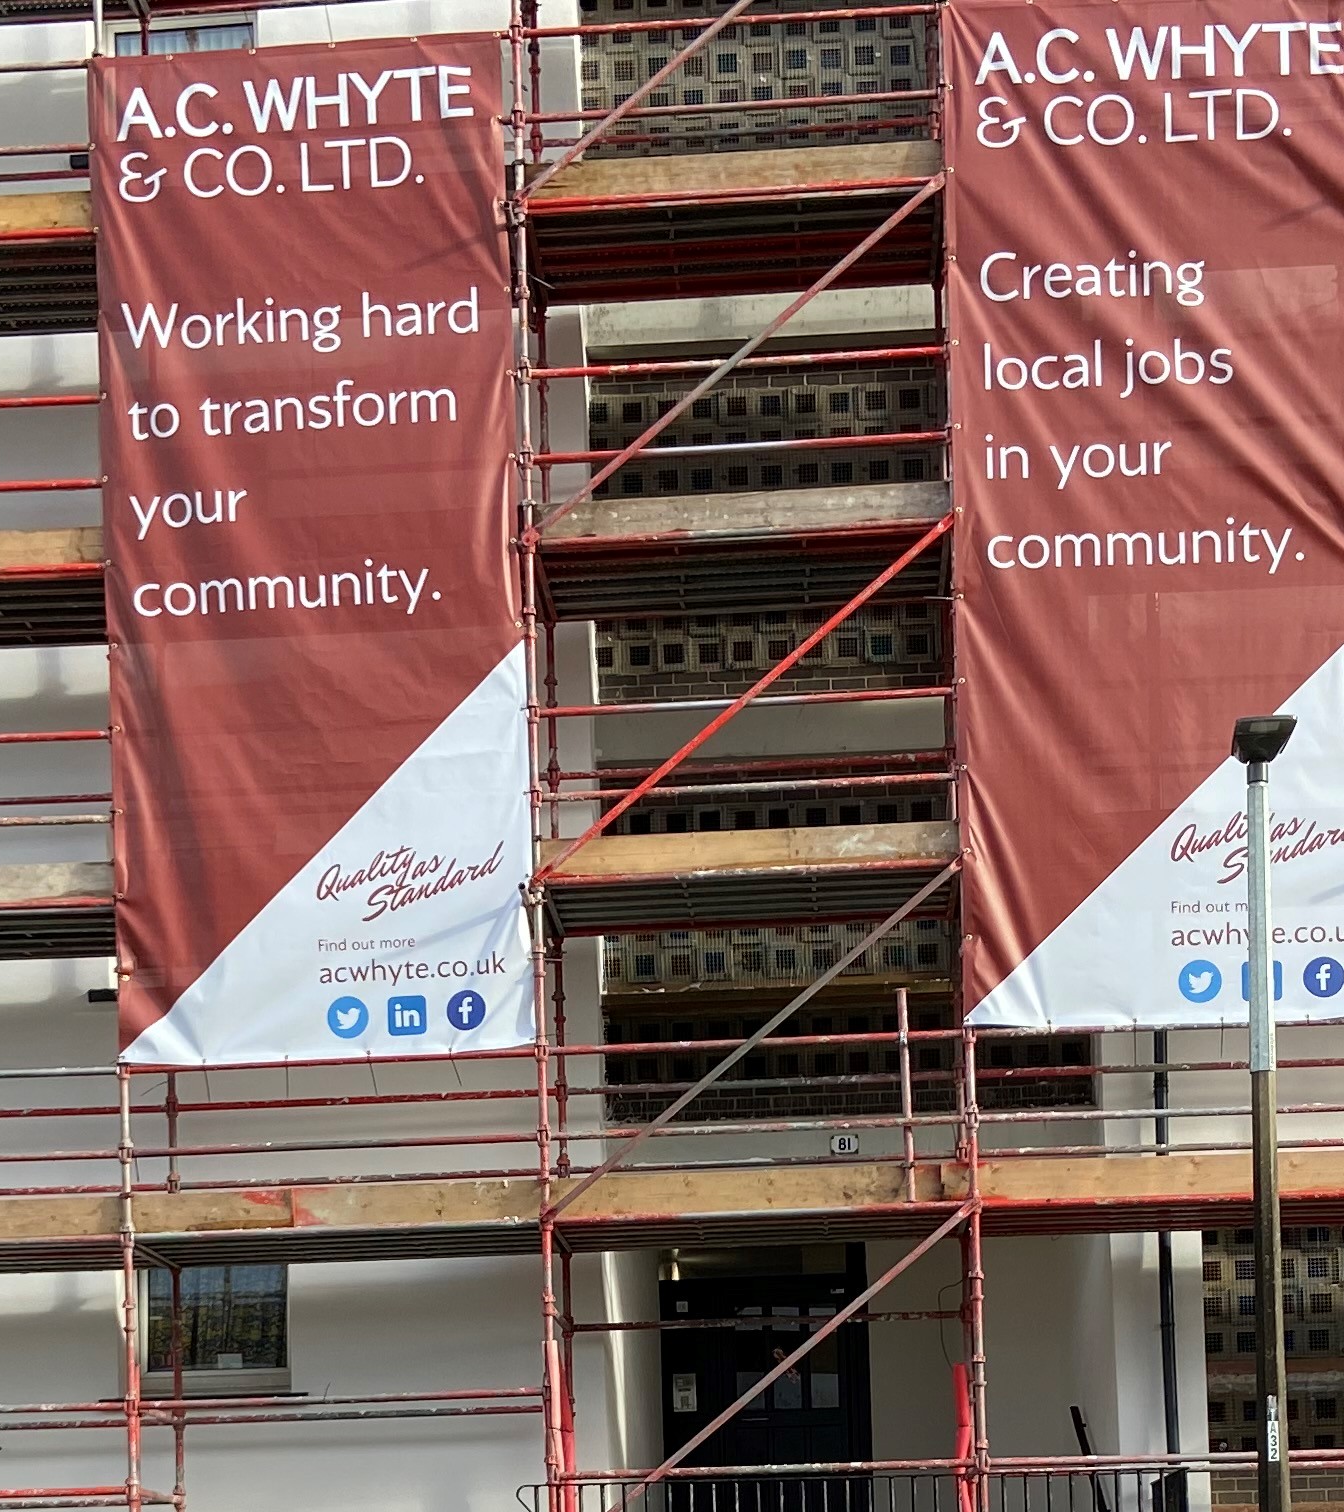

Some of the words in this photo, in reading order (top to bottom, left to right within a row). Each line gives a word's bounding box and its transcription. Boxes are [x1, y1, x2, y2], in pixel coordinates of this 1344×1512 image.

[975, 29, 1094, 85] A.C.
[1106, 22, 1344, 80] WHYTE
[117, 83, 233, 141] A.C.
[243, 66, 473, 132] WHYTE
[977, 97, 1026, 148] &
[1044, 94, 1146, 145] CO.
[1165, 89, 1291, 142] LTD.
[119, 152, 167, 202] &
[184, 145, 284, 197] CO.
[301, 137, 423, 191] LTD.
[981, 250, 1204, 306] Creating
[122, 298, 341, 352] Working
[363, 287, 478, 337] hard
[984, 340, 1102, 390] local
[1120, 339, 1233, 398] jobs
[128, 402, 179, 440] to
[199, 380, 456, 435] transform
[986, 434, 1028, 479] in
[1050, 441, 1172, 489] your
[130, 490, 247, 540] your
[988, 518, 1304, 574] community.
[134, 559, 440, 616] community.
[1170, 811, 1275, 862] Quali
[1270, 817, 1306, 842] as
[316, 845, 417, 902] Quality
[412, 855, 446, 880] as
[362, 840, 504, 921] Standard
[1171, 901, 1200, 913] Find
[1206, 902, 1230, 913] out
[318, 939, 347, 952] Find
[352, 939, 375, 950] out
[380, 937, 416, 949] more
[320, 951, 506, 986] acwhyte.co.uk
[838, 1137, 851, 1150] 81
